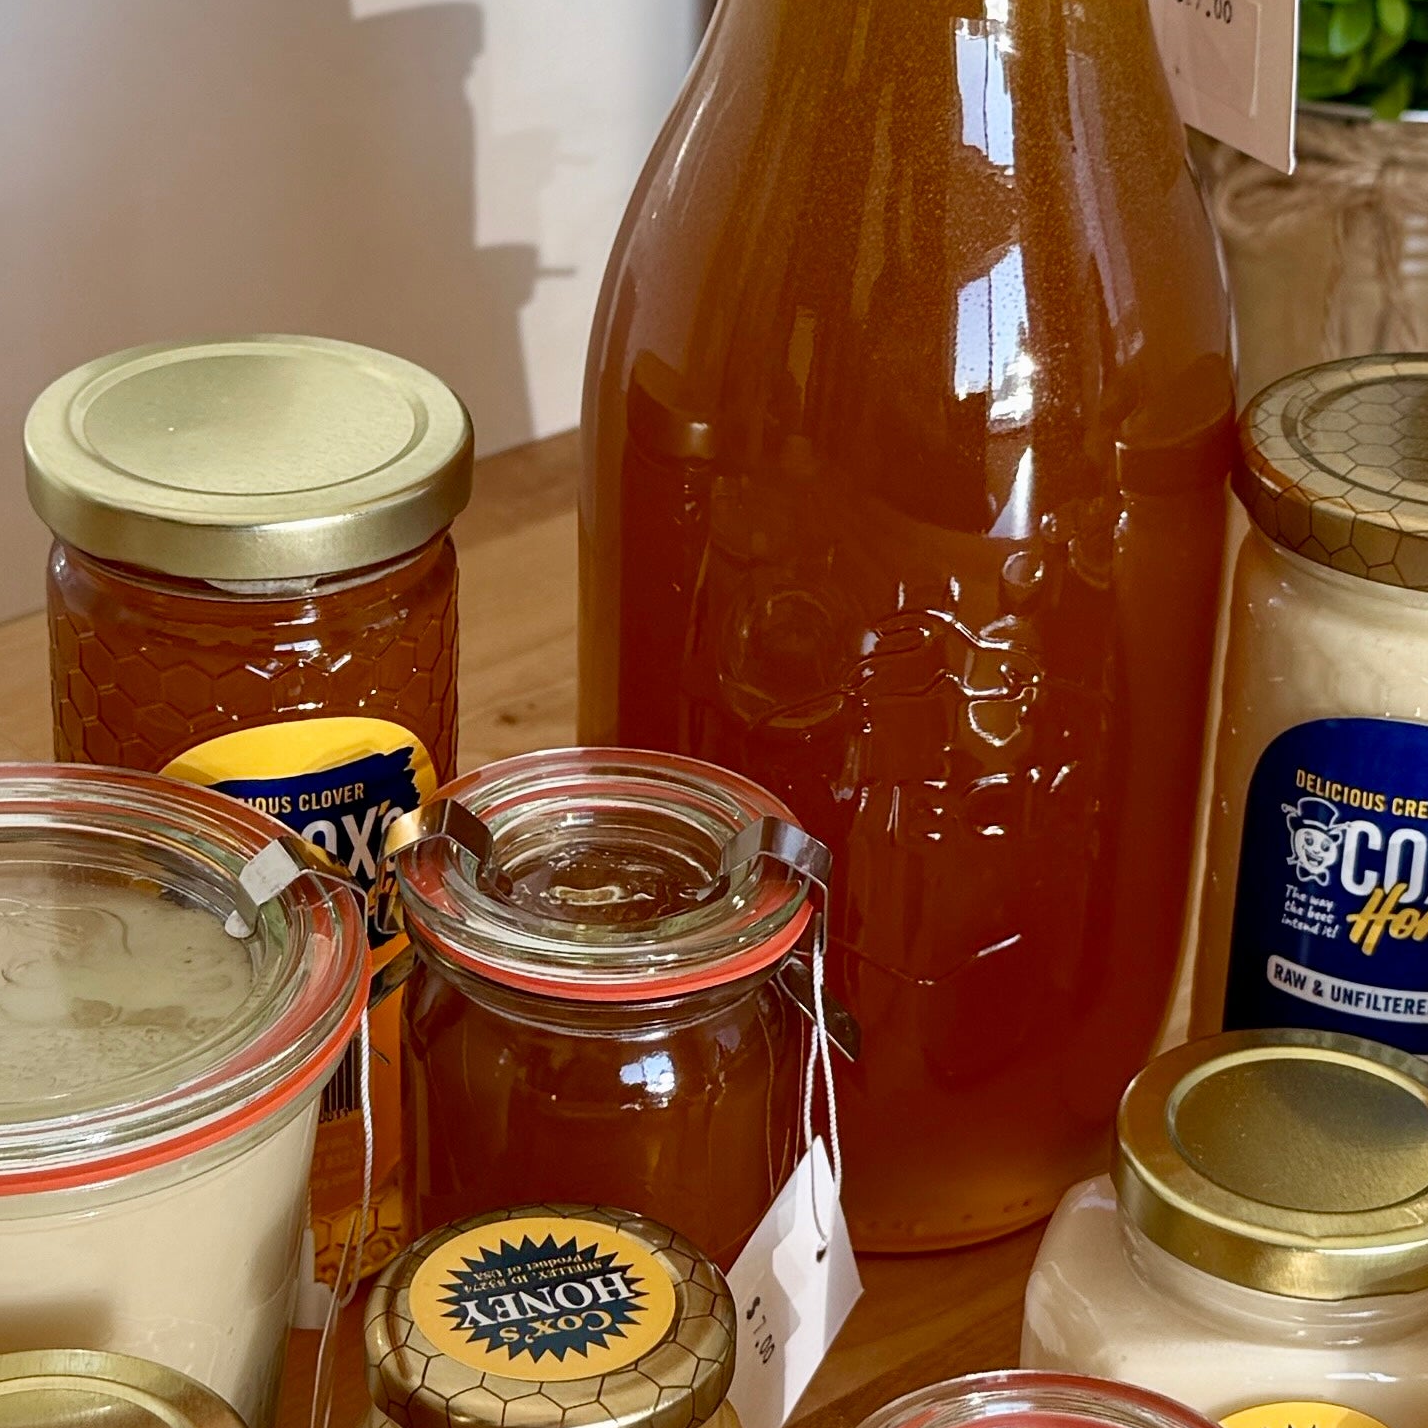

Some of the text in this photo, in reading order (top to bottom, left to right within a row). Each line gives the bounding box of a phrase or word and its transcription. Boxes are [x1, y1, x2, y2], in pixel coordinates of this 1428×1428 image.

[298, 782, 365, 811] CLOVER
[1296, 769, 1386, 812] DELICIOUS
[1273, 963, 1307, 991] RAW
[1312, 979, 1324, 997] &
[460, 1271, 636, 1328] HONEY
